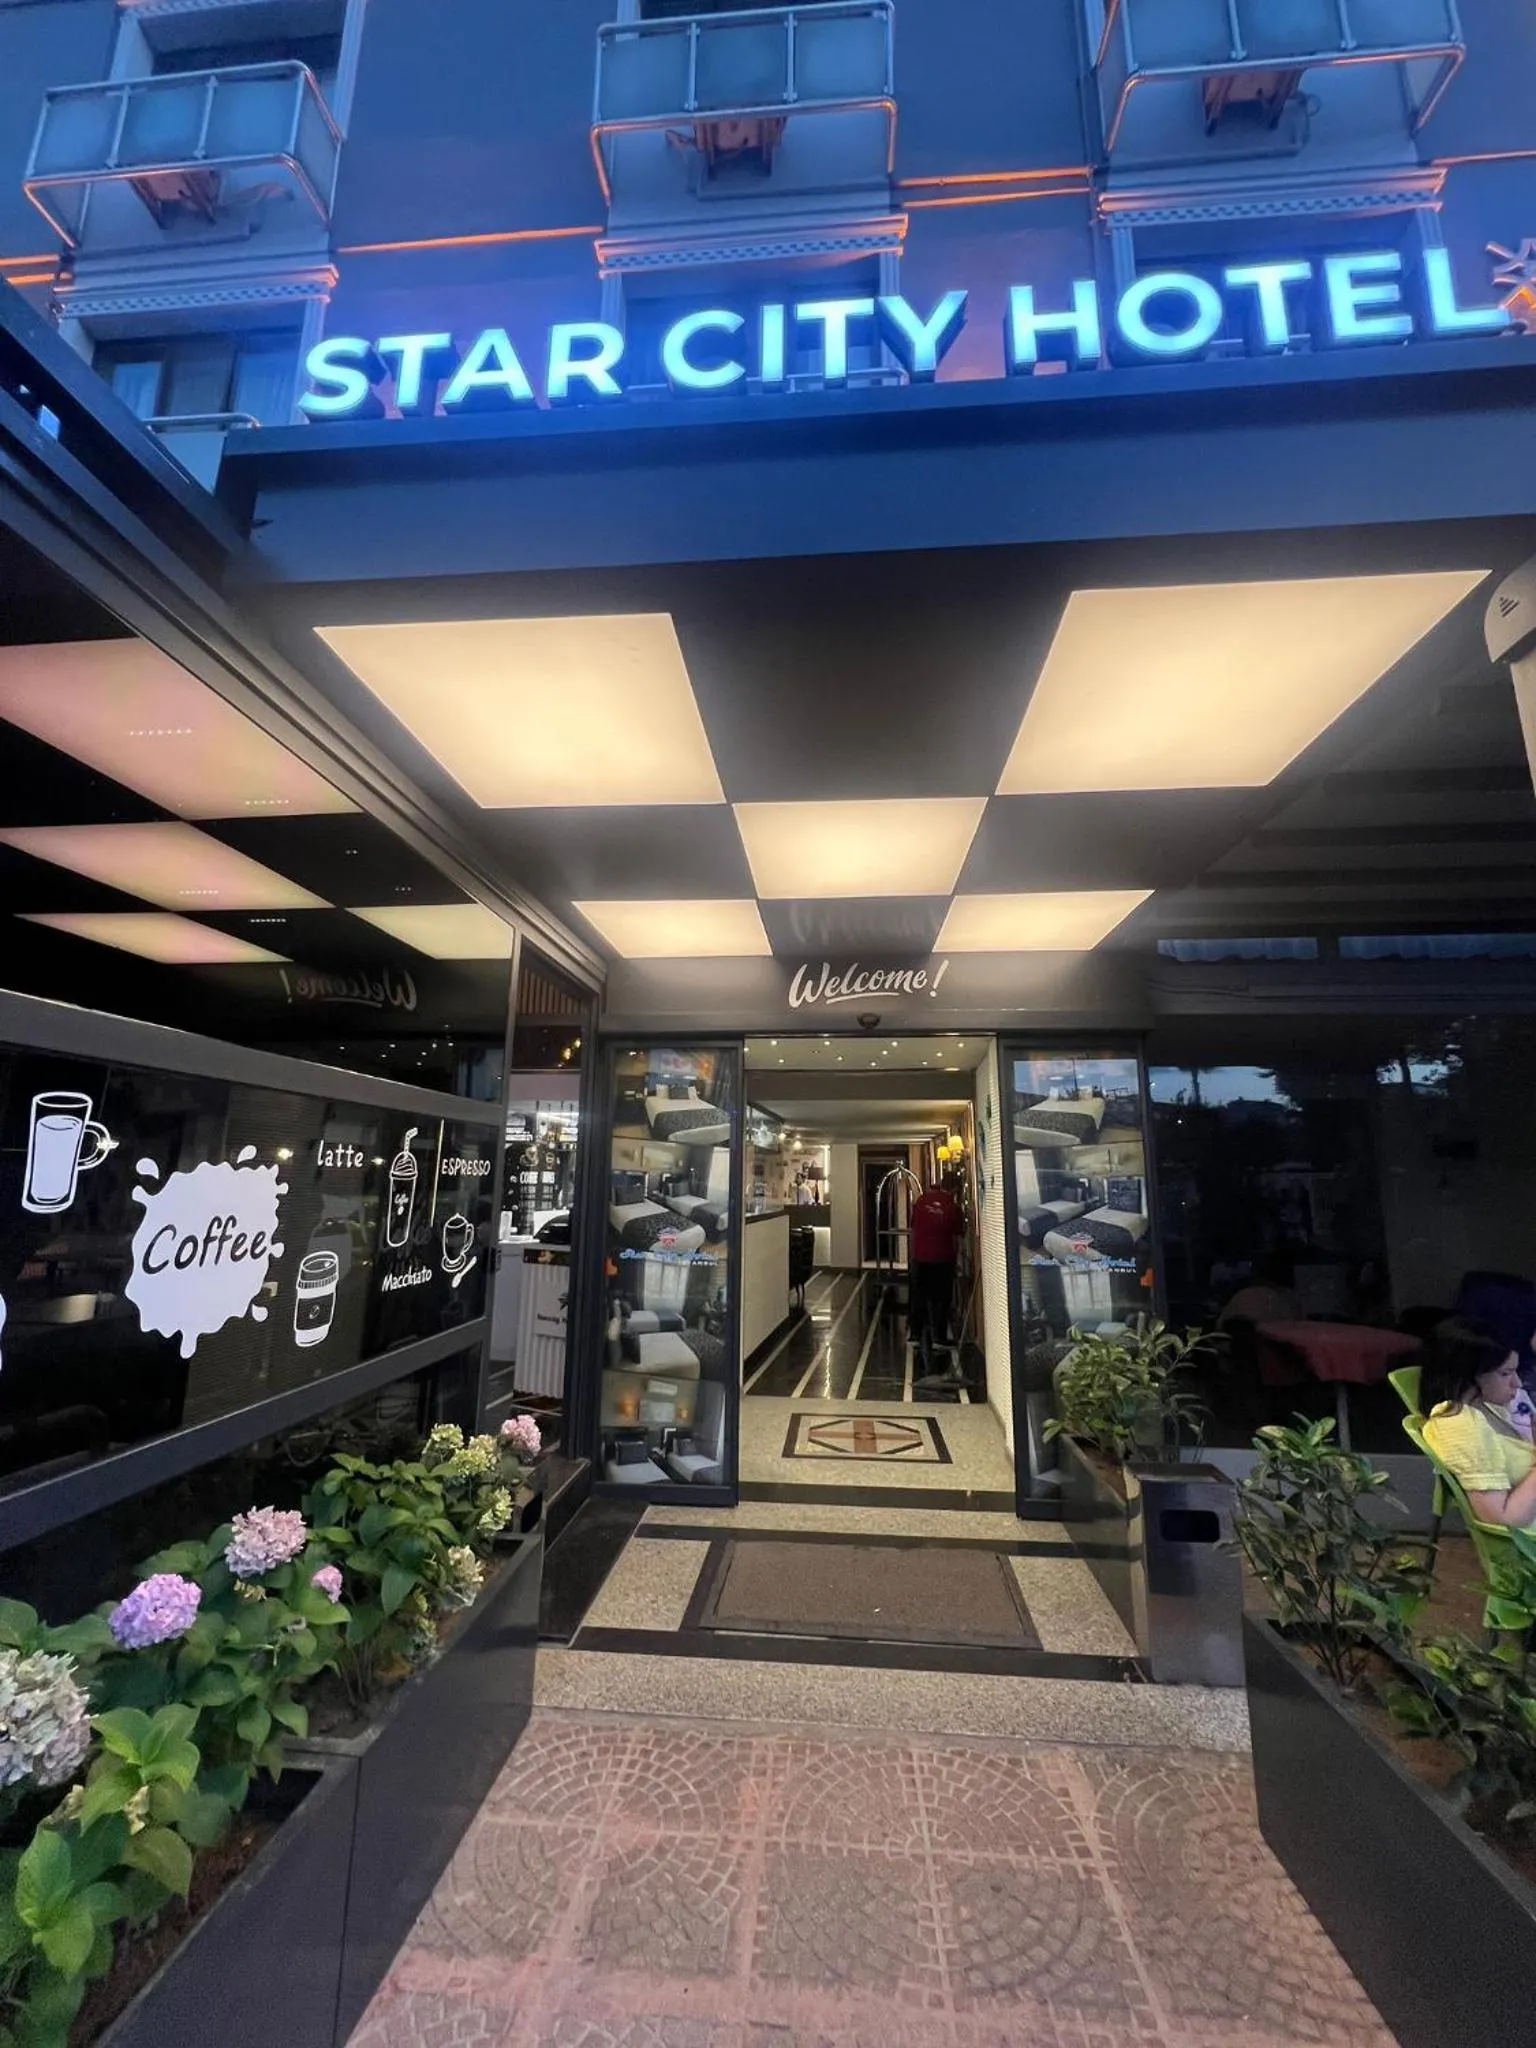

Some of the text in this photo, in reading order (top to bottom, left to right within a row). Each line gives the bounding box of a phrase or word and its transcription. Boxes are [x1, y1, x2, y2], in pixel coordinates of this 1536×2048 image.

[299, 246, 1511, 417] STAR CITY HOTEL
[788, 959, 950, 1008] Welcome!
[317, 1139, 364, 1168] latte
[441, 1158, 491, 1176] ESPRESSO
[142, 1215, 267, 1274] Coffee
